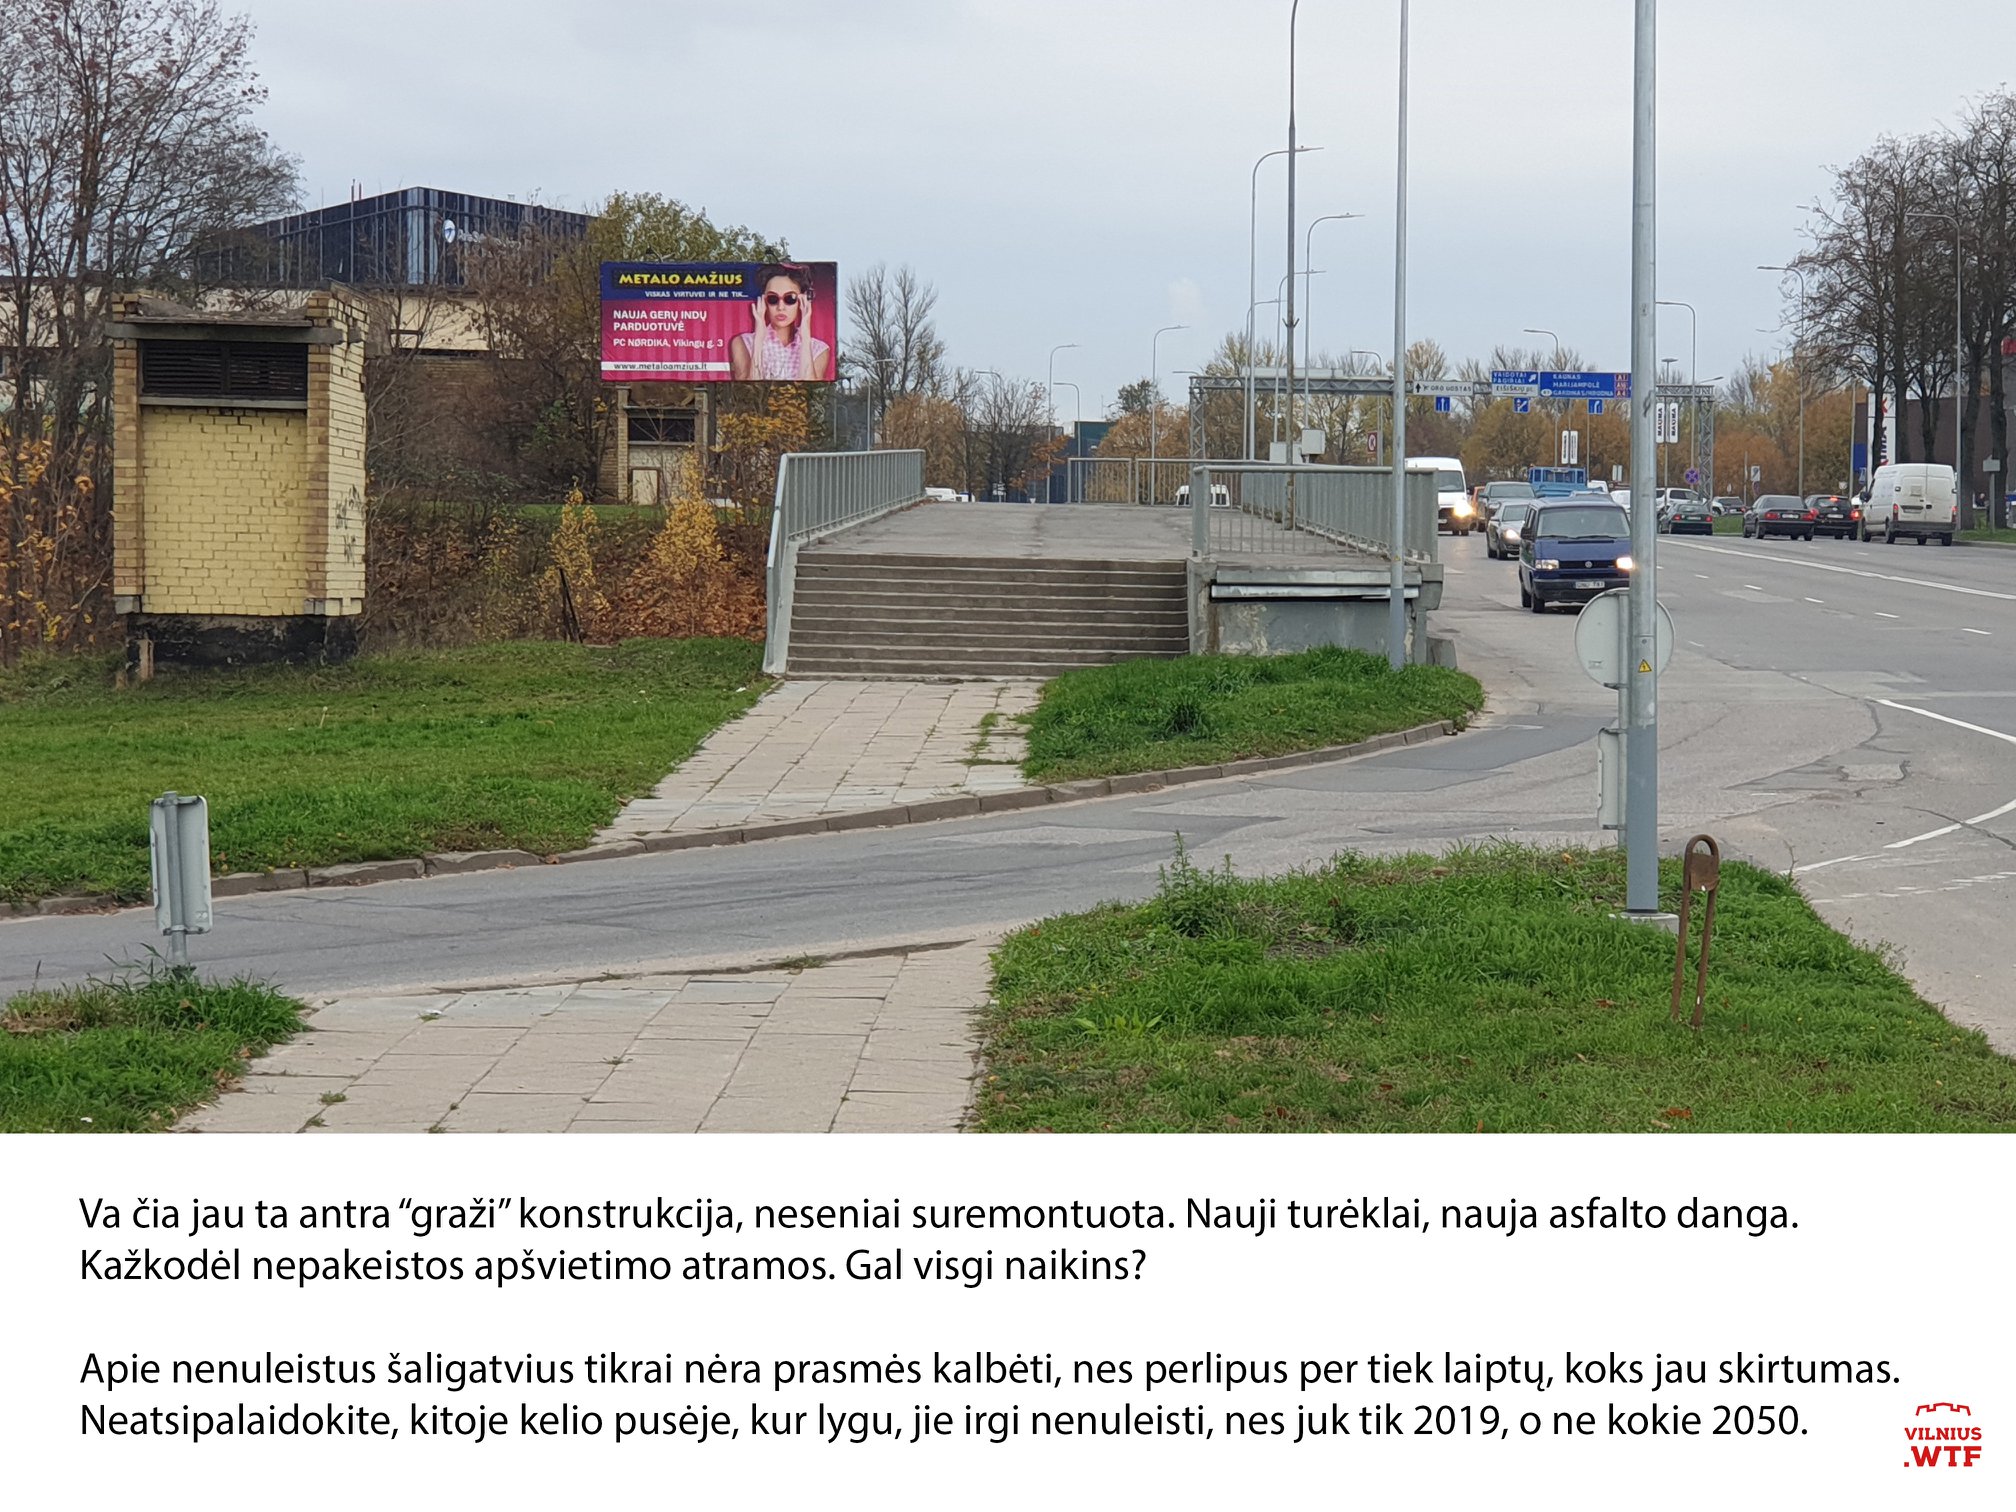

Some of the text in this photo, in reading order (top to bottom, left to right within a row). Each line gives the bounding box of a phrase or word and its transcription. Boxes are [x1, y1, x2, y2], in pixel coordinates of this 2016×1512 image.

[619, 271, 743, 285] METALO AMŽIUS
[613, 310, 707, 322] NAUJA GERŲ INDŲ
[613, 321, 685, 331] PARDUOTUVĖ
[613, 338, 724, 349] PC NØRDIKA, Vikingų g. 3
[614, 362, 707, 370] www.metaloamzius.lt
